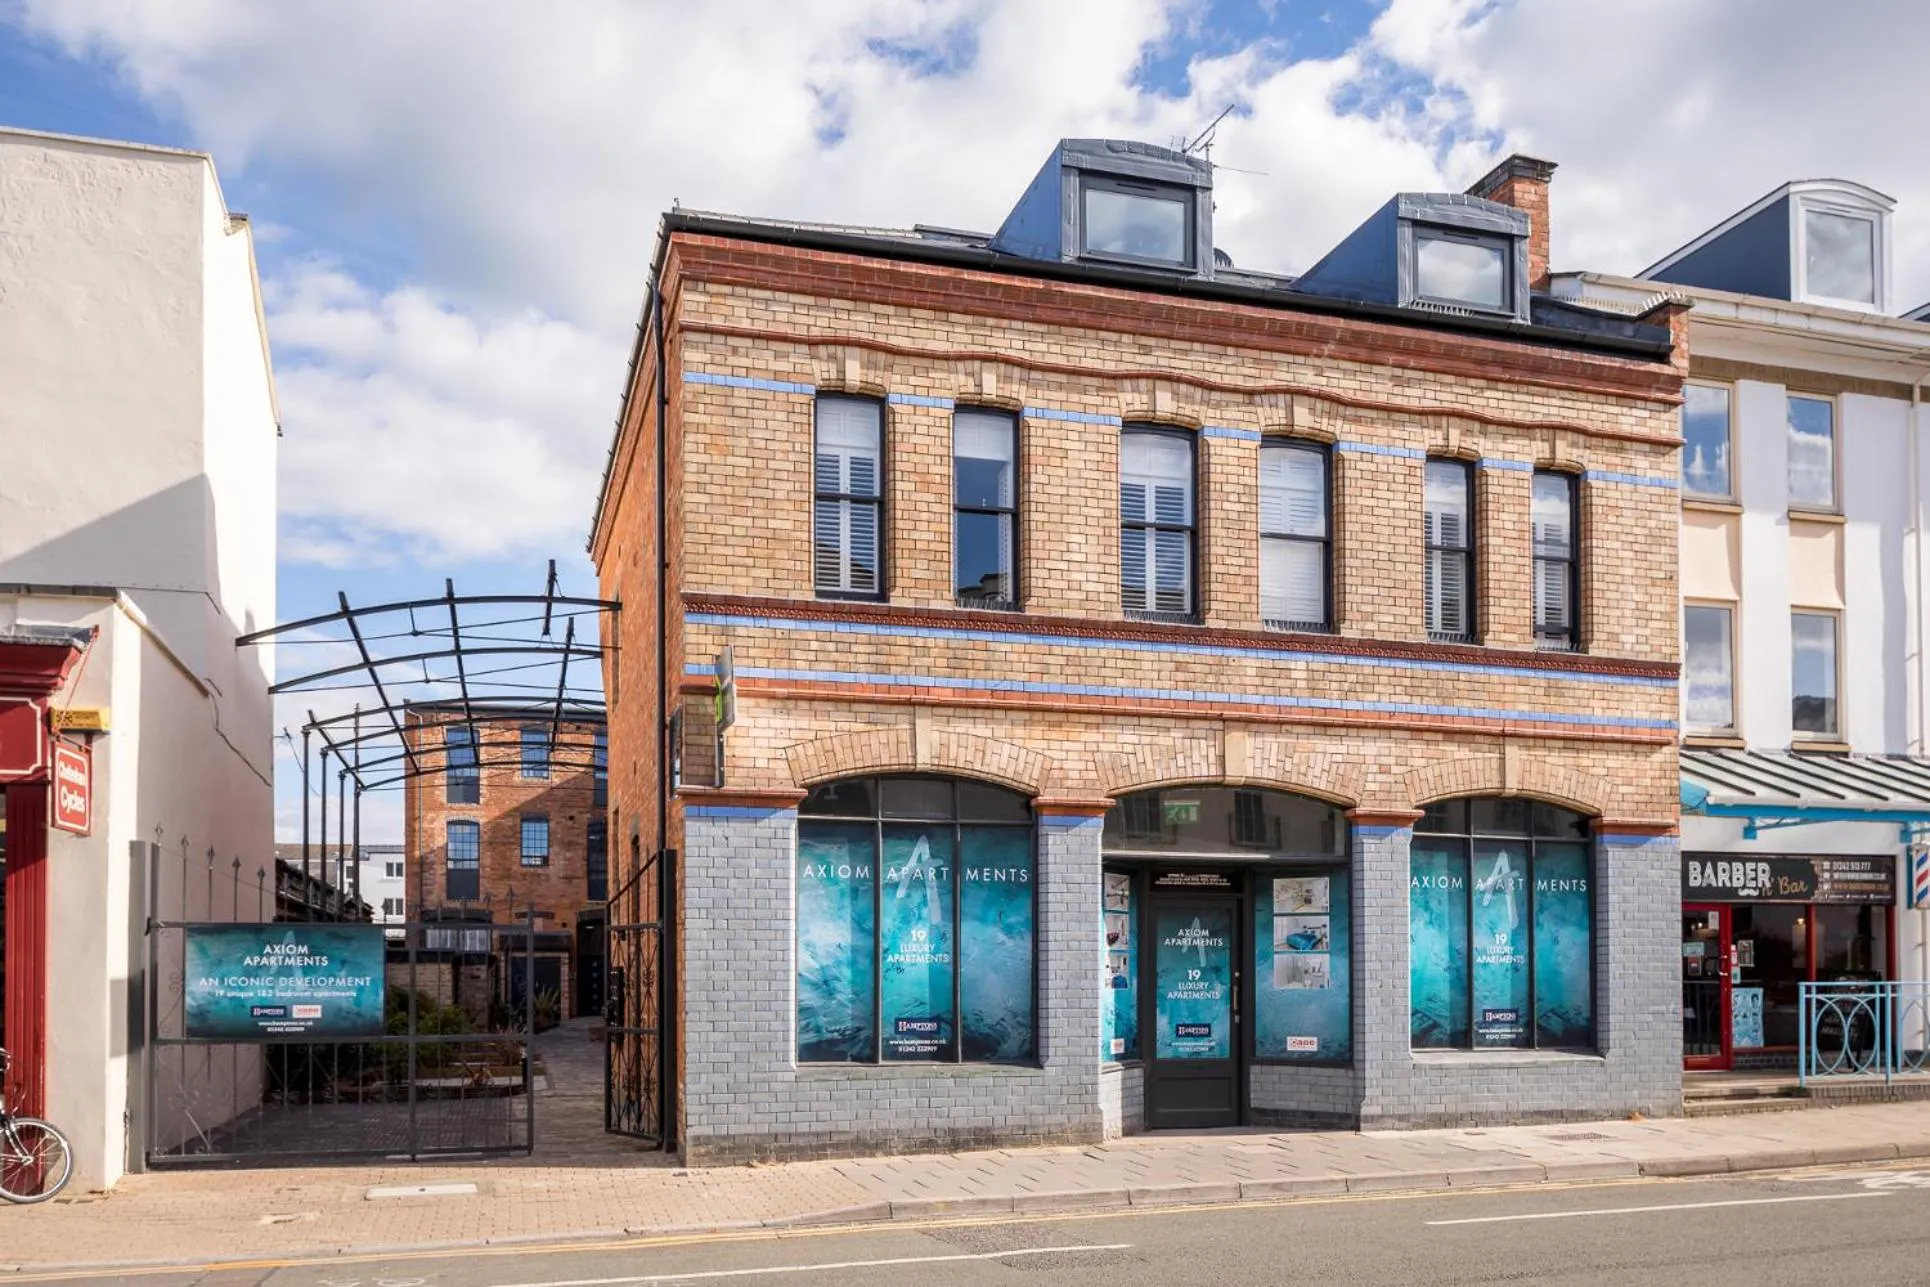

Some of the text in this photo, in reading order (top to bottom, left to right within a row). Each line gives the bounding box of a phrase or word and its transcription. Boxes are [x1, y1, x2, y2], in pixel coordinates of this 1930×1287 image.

[60, 785, 86, 813] Cycles
[802, 864, 1029, 882] AXIOM APART MENTS
[1688, 860, 1771, 888] BARBER
[1777, 875, 1809, 896] Bar
[1411, 876, 1463, 889] AXIOM
[1537, 879, 1587, 893] MENTS
[910, 929, 927, 941] 19
[1178, 928, 1210, 938] AXIOM
[1494, 932, 1508, 945] 19
[1163, 937, 1224, 947] APARTMENTS
[263, 944, 309, 955] AXIOM
[900, 943, 935, 953] LUXURY
[1487, 945, 1514, 954] LUXURY
[243, 955, 329, 967] APARTMENTS
[886, 953, 950, 963] APARTMENTS
[1476, 954, 1525, 964] APARTMENTS
[1187, 969, 1201, 981] 19
[199, 976, 371, 988] AN ICONIC DEVELOPMENT
[1178, 981, 1209, 990] LUXURY
[215, 989, 225, 997] 19
[1167, 990, 1221, 1000] APARTMENTS
